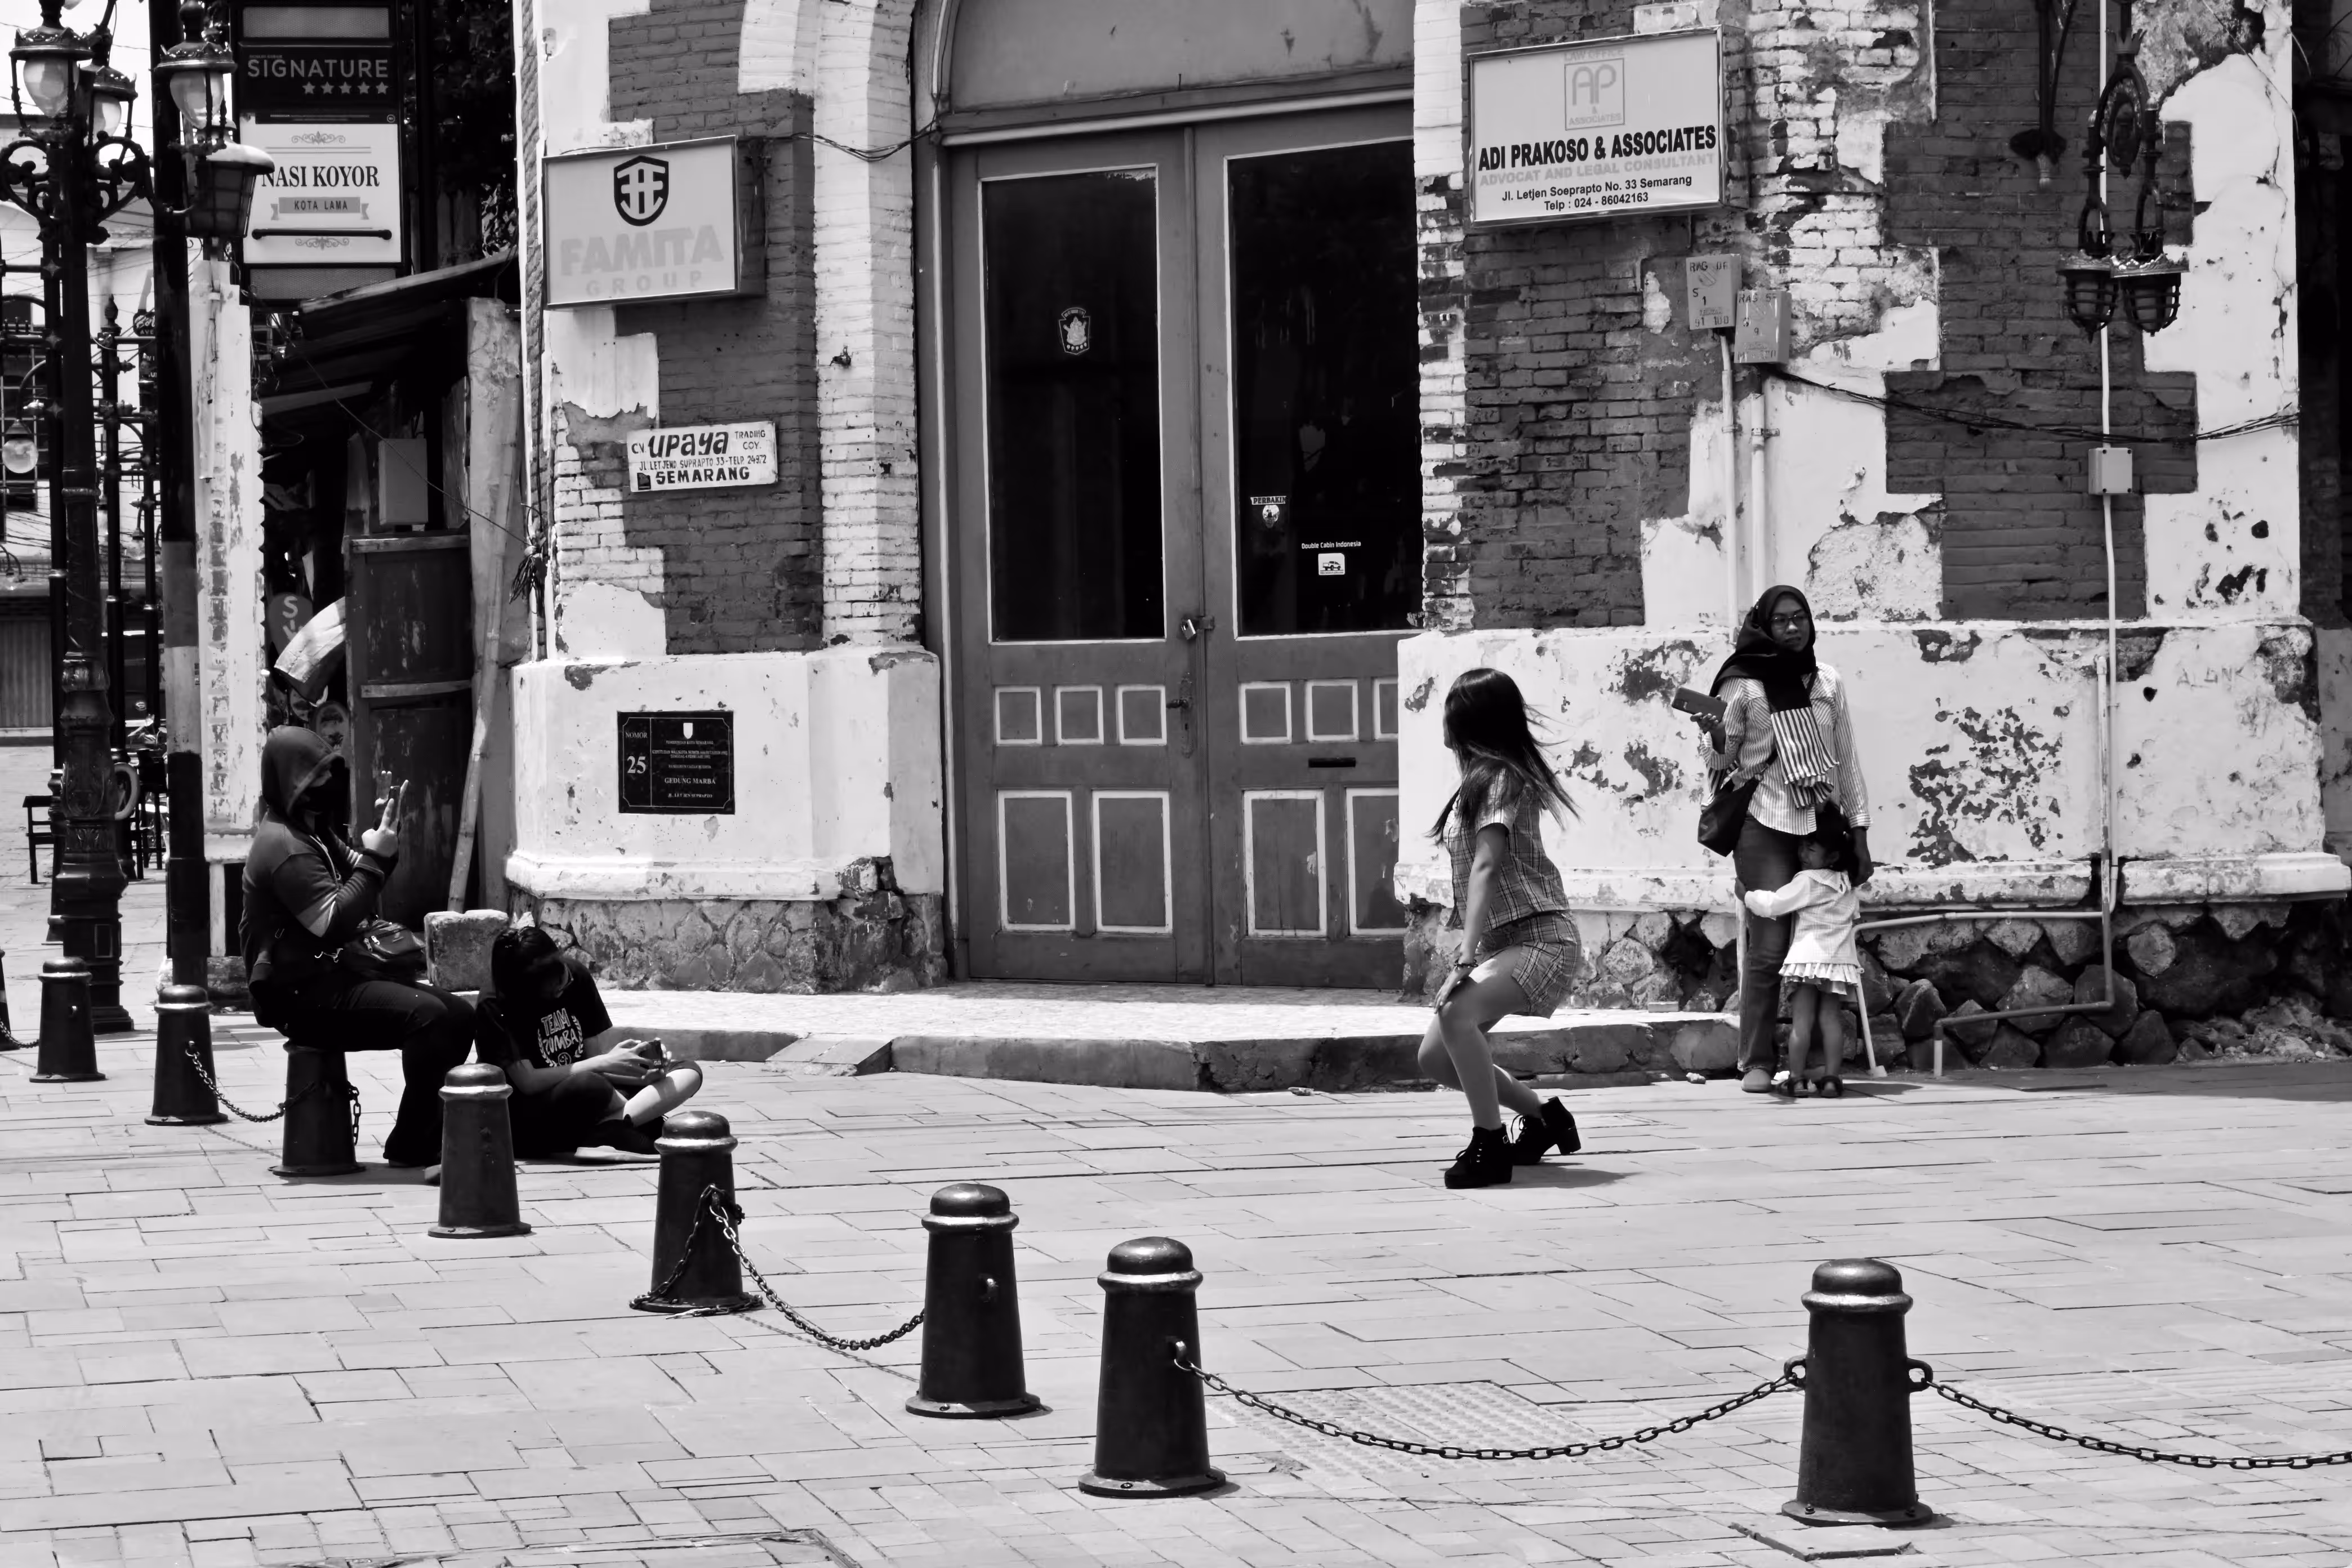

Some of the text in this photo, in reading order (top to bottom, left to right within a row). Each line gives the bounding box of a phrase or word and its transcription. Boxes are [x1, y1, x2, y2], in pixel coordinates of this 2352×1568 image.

[247, 59, 389, 78] SIGNATURE
[1478, 125, 1716, 171] ADI PRAKOSO & ASSOCIATES
[261, 166, 380, 187] NASI KOYOR
[1480, 153, 1715, 186] ADVOCAT AND LEGAL CONSULTANT
[1502, 176, 1692, 201] Jl. Letjen Soeprapto No. 33 Semarang
[294, 200, 348, 211] KOTA LAMA
[1544, 200, 1565, 212] Telp
[1574, 197, 1592, 208] 024
[1601, 192, 1649, 206] 86042163
[560, 224, 724, 276] FAMITA
[586, 270, 703, 297] GROUP
[742, 441, 762, 450] COY.
[680, 457, 714, 469] SUPRAPTO
[655, 466, 750, 485] SEMARANG
[1253, 496, 1286, 505] PERBAKIN
[283, 595, 299, 618] S
[626, 755, 647, 774] 25
[541, 1007, 571, 1036] TEAM
[542, 1027, 579, 1055] ZUMBA
